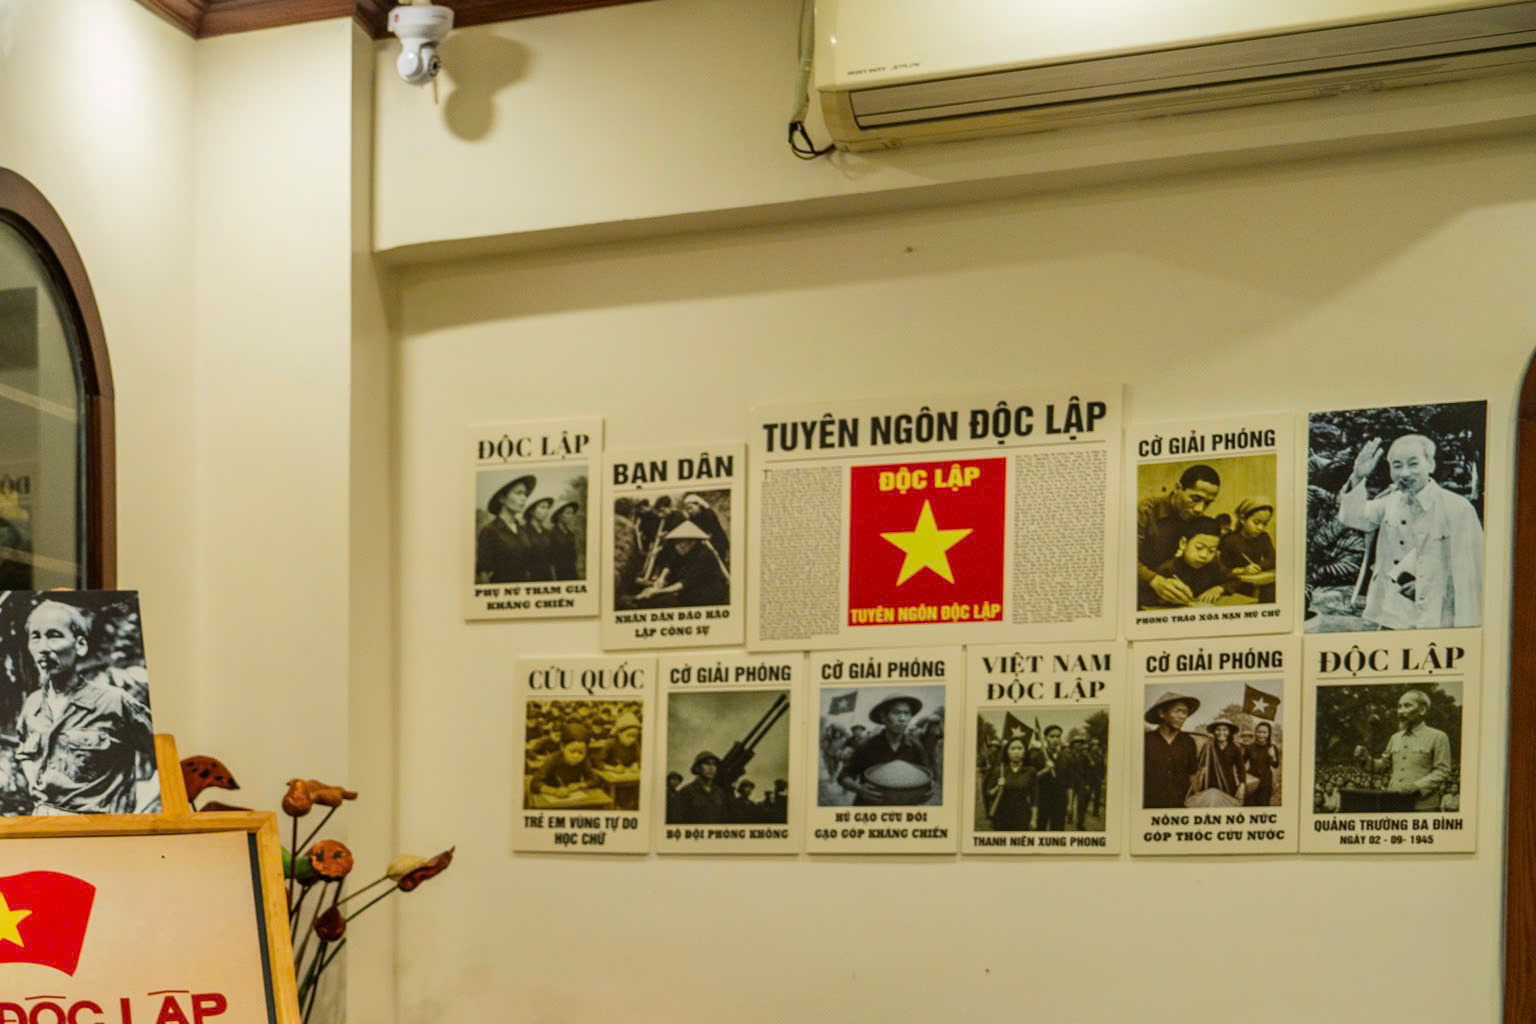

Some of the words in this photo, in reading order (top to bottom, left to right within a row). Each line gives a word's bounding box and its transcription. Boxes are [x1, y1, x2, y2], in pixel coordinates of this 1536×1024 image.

[763, 413, 860, 452] TUYÊN
[870, 406, 958, 446] NGÔN
[969, 401, 1034, 445] ĐỘC
[1045, 396, 1107, 440] LẬP
[477, 434, 532, 464] ĐỘC
[541, 430, 590, 460] LẬP
[1137, 434, 1163, 457] CỜ
[1168, 430, 1205, 455] GIẢI
[1211, 428, 1276, 451] PHÓNG
[613, 460, 667, 489] BẠN
[677, 452, 734, 481] DÂN
[879, 467, 929, 495] ĐỘC
[934, 463, 981, 492] LẬP
[475, 588, 500, 598] PHỤ
[525, 585, 562, 595] THAM
[565, 584, 587, 594] GIA
[487, 600, 531, 610] KHÁNG
[851, 605, 895, 624] TUYÊN
[897, 603, 938, 622] NGÔN
[940, 602, 970, 622] ĐỘC
[973, 600, 1001, 621] LẬP
[615, 614, 647, 624] NHÂN
[651, 611, 674, 622] DÂN
[678, 610, 702, 620] ĐÀO
[1171, 614, 1196, 622] TRÀO
[1222, 611, 1241, 620] NẠN
[660, 625, 693, 637] CÔNG
[982, 651, 1044, 677] VIỆT
[1053, 653, 1111, 673] NAM
[1146, 651, 1171, 673] CỜ
[1175, 648, 1212, 672] GIẢI
[1218, 648, 1283, 670] PHÓNG
[1318, 644, 1389, 677] ĐỘC
[1401, 642, 1465, 674] LẬP
[670, 664, 692, 684] CỜ
[696, 662, 729, 683] GIẢI
[735, 661, 792, 682] PHÓNG
[821, 659, 844, 680] CỜ
[848, 657, 881, 679] GIẢI
[887, 657, 946, 678] PHÓNG
[528, 664, 570, 690] CỨU
[581, 661, 645, 695] QUỐC
[986, 678, 1044, 703] ĐỘC
[1053, 676, 1106, 703] LẬP
[524, 812, 544, 828] TRẺ
[548, 816, 566, 828] EM
[569, 814, 601, 829] VÙNG
[604, 816, 620, 831] TỰ
[622, 817, 638, 829] DO
[854, 812, 877, 823] GẠO
[1151, 814, 1189, 826] NÔNG
[1193, 813, 1221, 825] DÂN
[1314, 817, 1356, 832] QUẢNG
[1360, 817, 1408, 831] TRƯỜNG
[1412, 819, 1429, 830] BA
[1432, 816, 1463, 830] ĐÌNH
[554, 832, 578, 847] HỌC
[666, 827, 681, 841] BỘ
[685, 827, 705, 840] ĐỘI
[749, 827, 789, 839] KHÔNG
[814, 828, 838, 840] GẠO
[841, 828, 865, 839] GÓP
[868, 828, 908, 839] KHÁNG
[912, 825, 948, 838] CHIẾN
[1144, 830, 1172, 842] GÓP
[1176, 830, 1213, 841] THÓC
[1340, 834, 1365, 845] NGÀY
[1369, 835, 1381, 844] 02
[1410, 835, 1434, 844] 1945
[974, 836, 1007, 847] THANH
[1038, 836, 1067, 847] XUNG
[1070, 836, 1106, 847] PHONG
